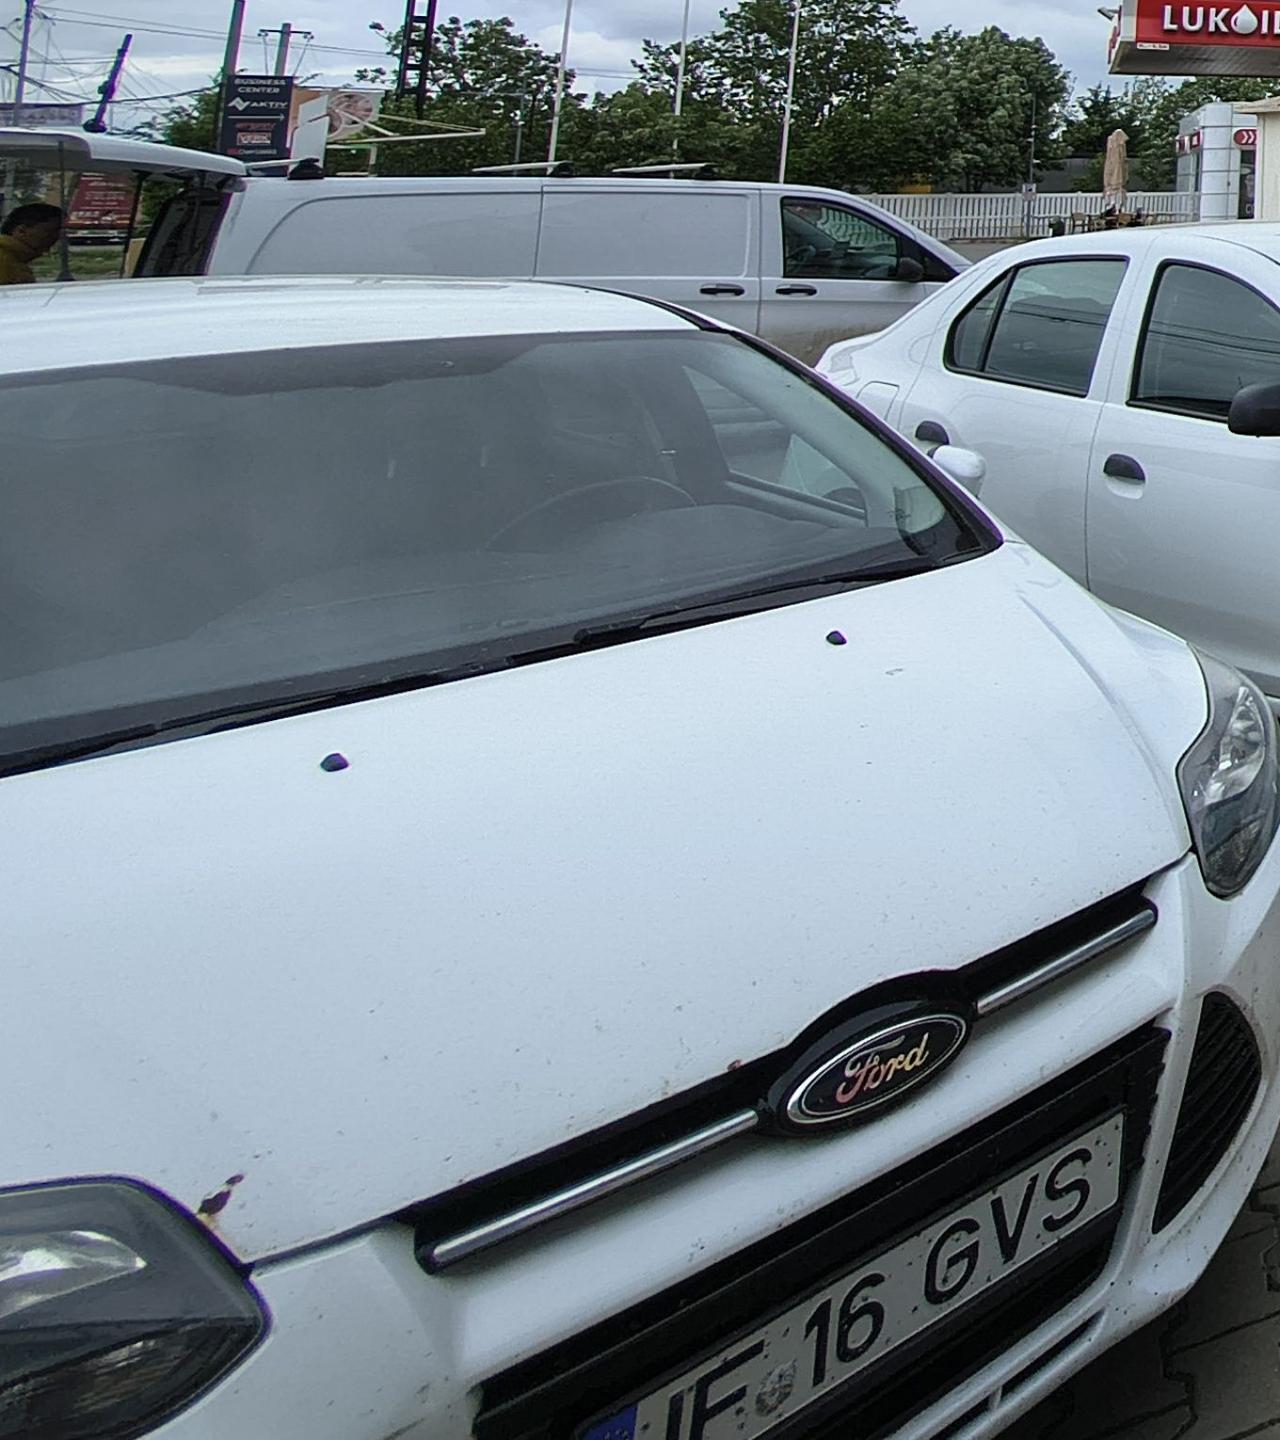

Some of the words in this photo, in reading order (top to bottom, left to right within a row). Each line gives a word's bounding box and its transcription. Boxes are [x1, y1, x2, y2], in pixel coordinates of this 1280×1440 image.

[835, 1033, 930, 1105] Ford
[804, 1272, 885, 1388] 16
[924, 1148, 1092, 1306] GVS
